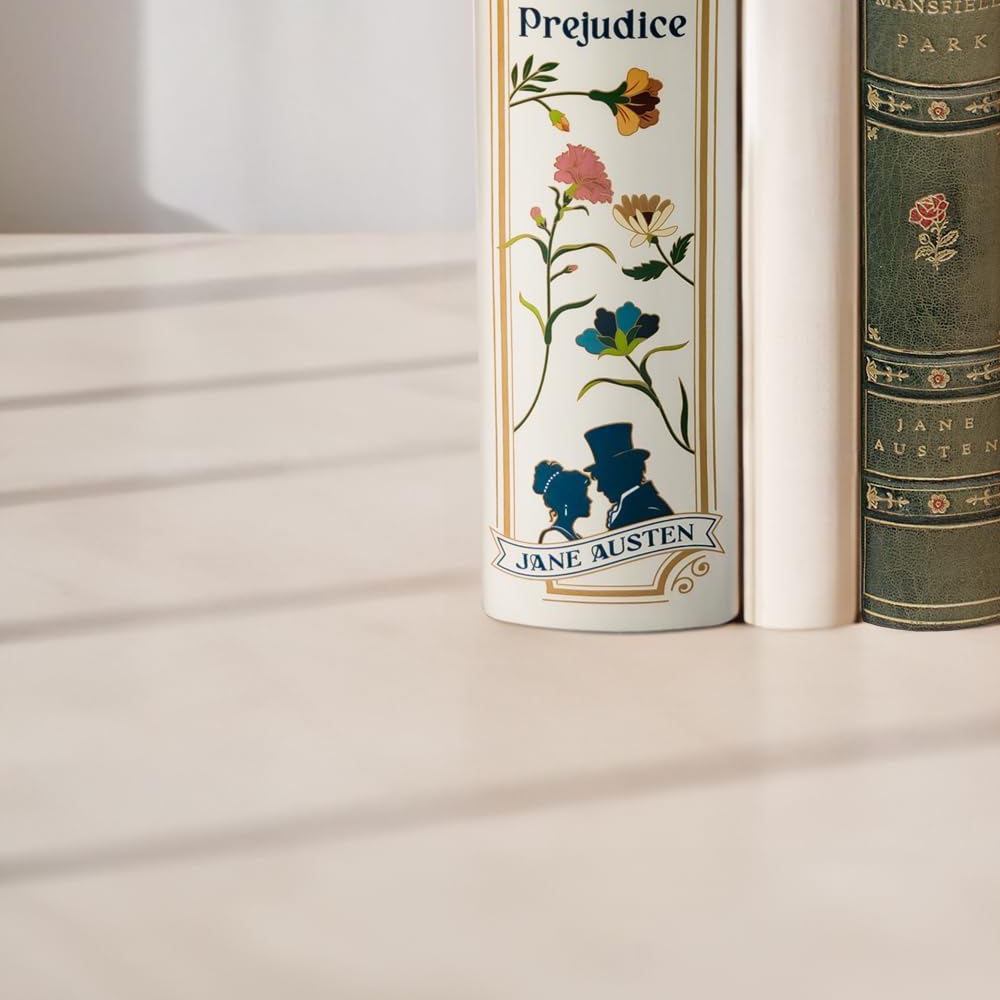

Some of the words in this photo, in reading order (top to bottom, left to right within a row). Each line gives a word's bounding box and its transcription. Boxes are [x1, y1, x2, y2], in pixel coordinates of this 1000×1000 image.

[518, 6, 687, 47] Prejudice
[897, 33, 988, 52] PARK
[897, 417, 974, 432] JANE
[874, 439, 998, 458] AUSTEN
[515, 550, 582, 571] JANE
[591, 523, 694, 562] AUSTEN
